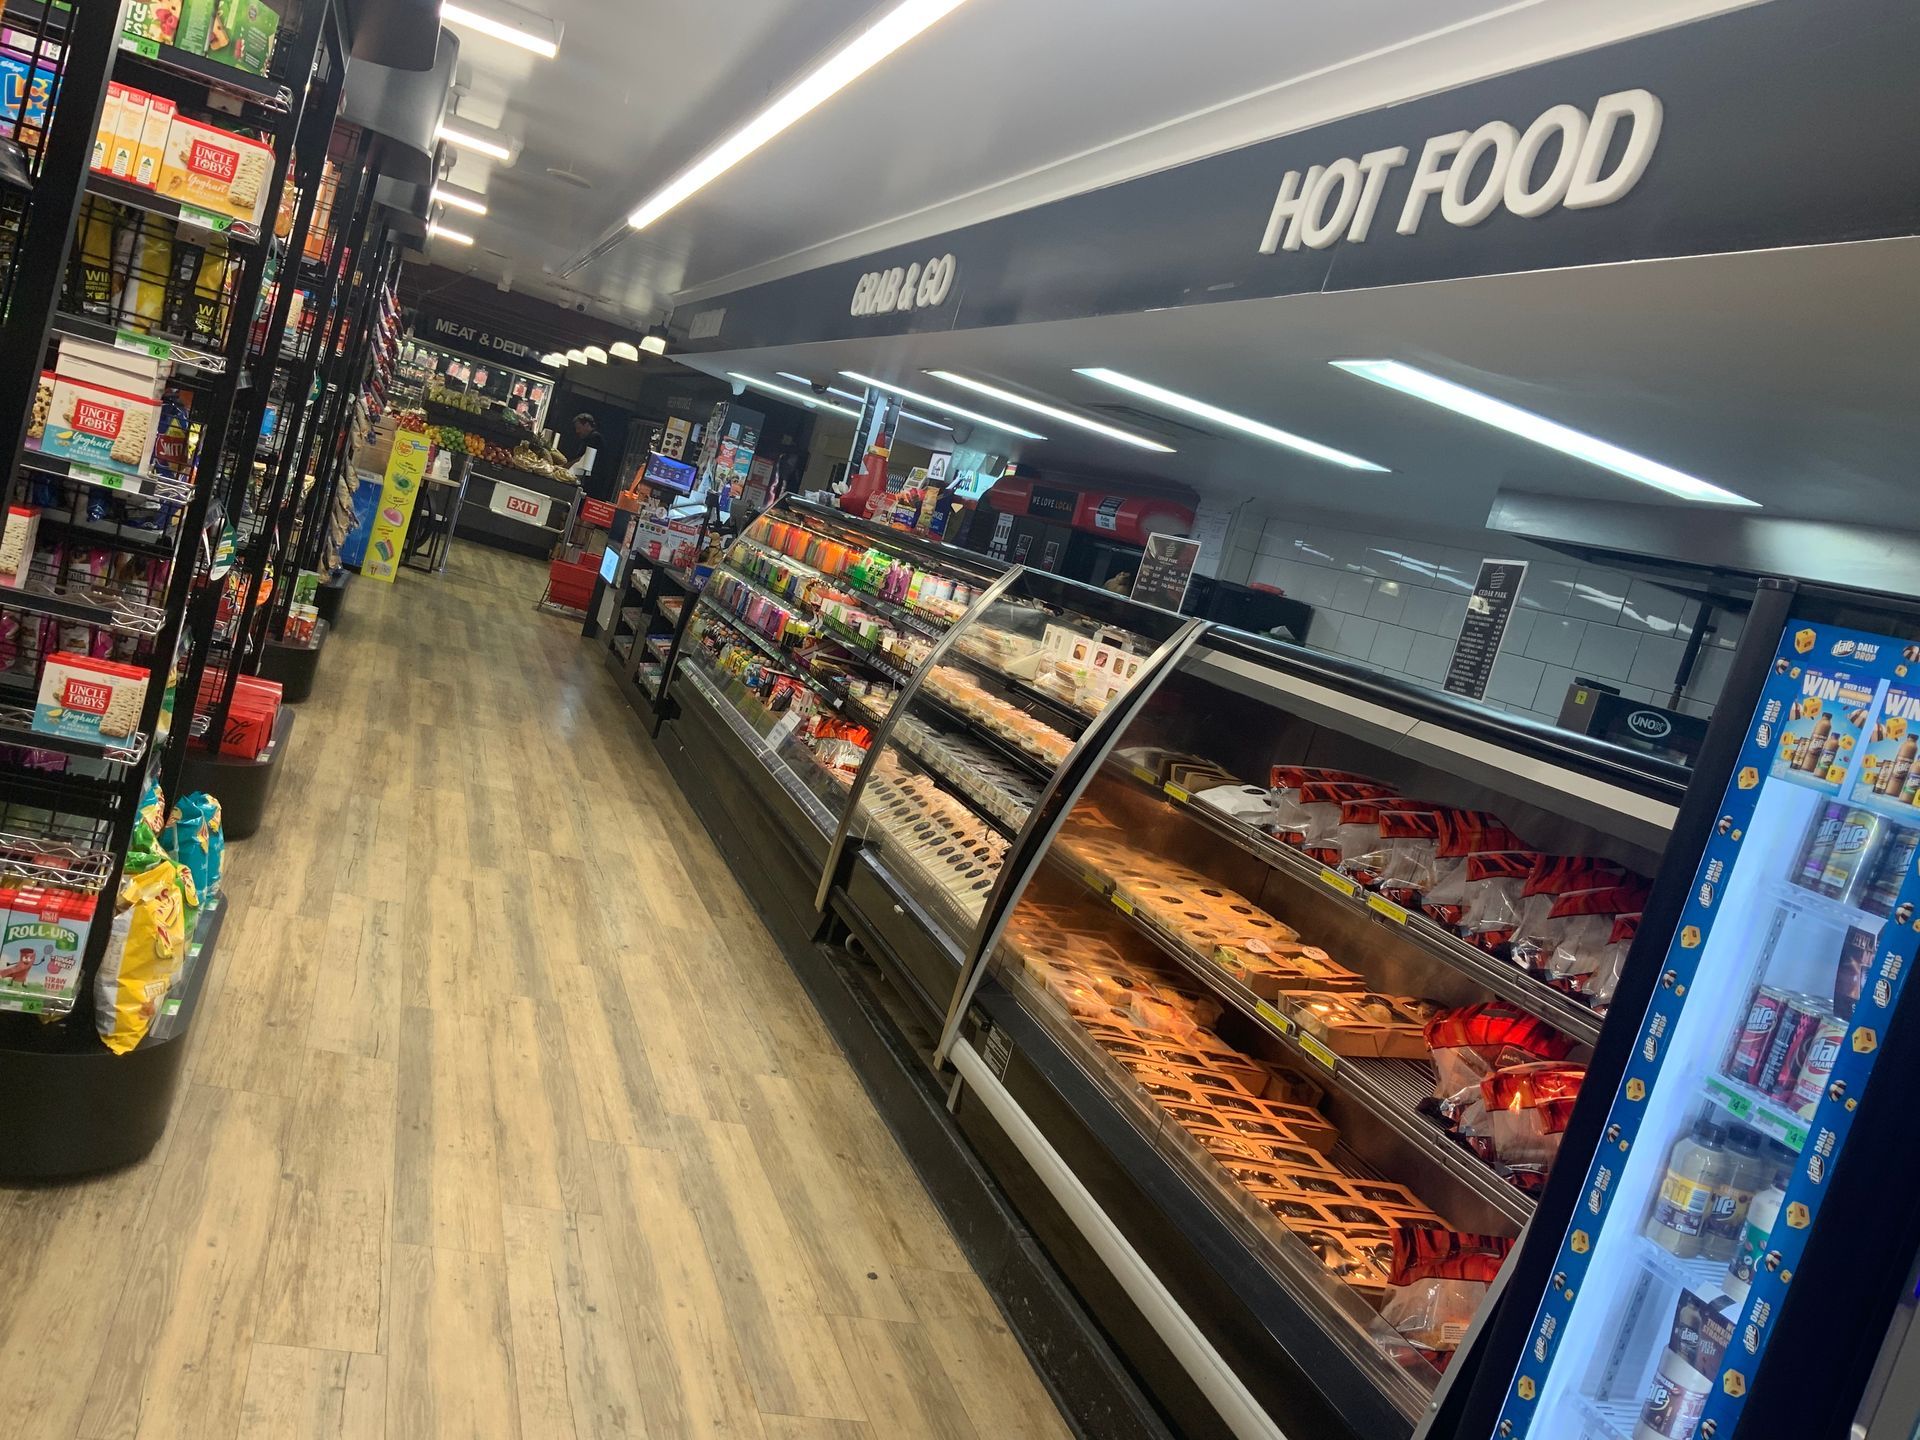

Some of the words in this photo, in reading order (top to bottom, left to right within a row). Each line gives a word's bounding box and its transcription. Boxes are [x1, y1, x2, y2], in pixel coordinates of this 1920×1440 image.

[193, 157, 232, 177] TOBYS
[195, 146, 234, 167] UNCLE
[1258, 146, 1410, 256] HOT
[1396, 88, 1664, 236] FOOD
[850, 267, 905, 317] GRAB
[896, 262, 921, 311] &
[916, 253, 957, 308] GO
[435, 318, 477, 342] MEAT
[479, 332, 491, 346] &
[492, 336, 529, 358] DELI
[78, 415, 116, 434] TOBYS
[79, 405, 118, 424] UNCLE
[72, 431, 113, 450] Yoghurt
[509, 498, 538, 516] EXIT
[1854, 651, 1876, 662] DROP
[1857, 642, 1880, 653] DAILY
[69, 684, 106, 700] UNCLE
[1802, 674, 1841, 701] WIN
[67, 694, 105, 710] TOBYS
[1762, 698, 1775, 721] DAILY
[1769, 700, 1782, 723] DROP
[1885, 693, 1920, 722] WIN
[62, 709, 100, 726] Yoghurt
[1632, 715, 1664, 733] UNOX
[1705, 858, 1718, 881] DAILY
[1711, 860, 1724, 883] DROP
[8, 925, 76, 943] ROLL-UPS
[1880, 951, 1896, 978] DAILY
[1888, 954, 1903, 980] DROP
[1649, 1012, 1661, 1035] DAILY
[1655, 1015, 1667, 1038] DROP
[1814, 1127, 1829, 1153] DAILY
[1821, 1132, 1836, 1157] DROP
[1594, 1164, 1607, 1188] DAILY
[1600, 1169, 1611, 1191] DROP
[1749, 1297, 1765, 1322] DAILY
[1757, 1302, 1771, 1328] DROP
[1540, 1312, 1551, 1335] DAILY
